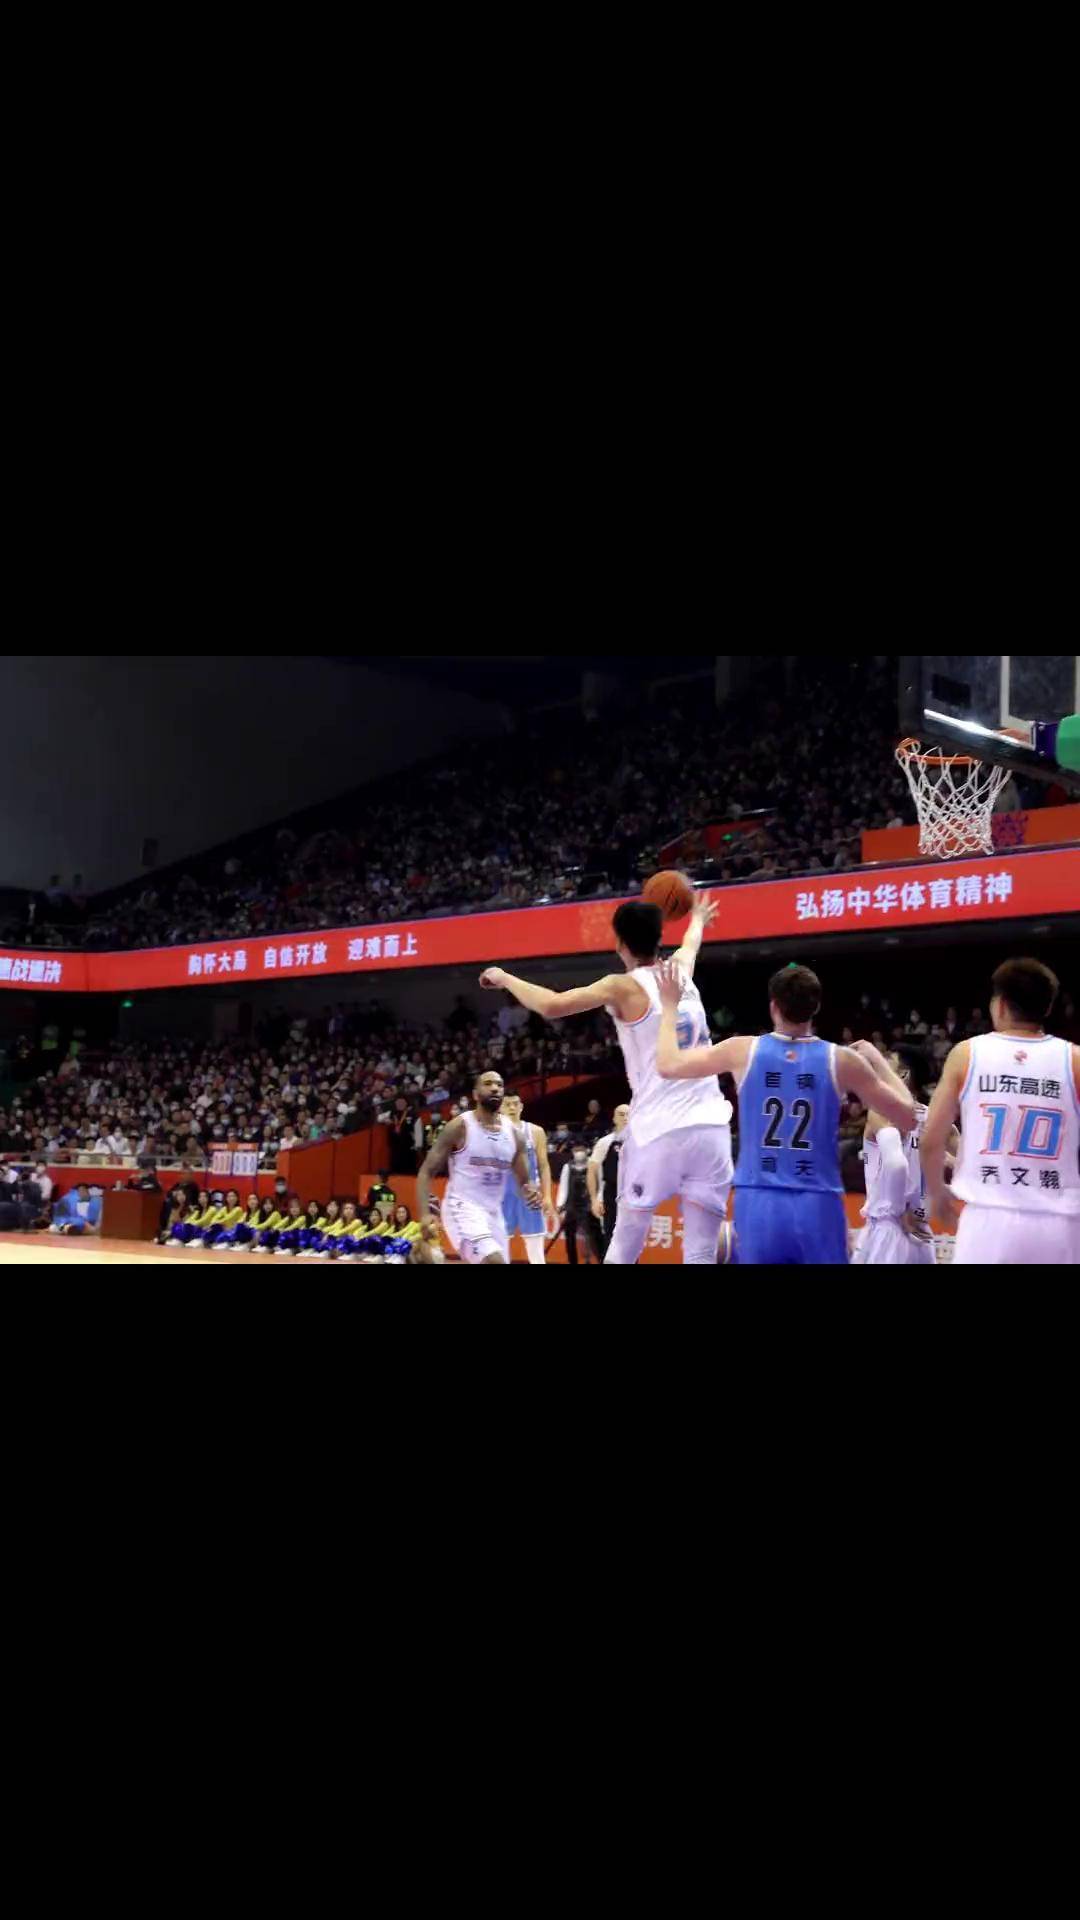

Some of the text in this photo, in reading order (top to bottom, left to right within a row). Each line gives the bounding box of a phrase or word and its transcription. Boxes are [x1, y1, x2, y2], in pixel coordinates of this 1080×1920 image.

[796, 872, 1013, 921] 弘扬中华体育精神
[263, 941, 328, 969] 自信开放
[347, 932, 418, 961] 迎难而上
[979, 1074, 1061, 1099] 山东高速
[762, 1096, 813, 1150] 22
[979, 1103, 1064, 1160] 10
